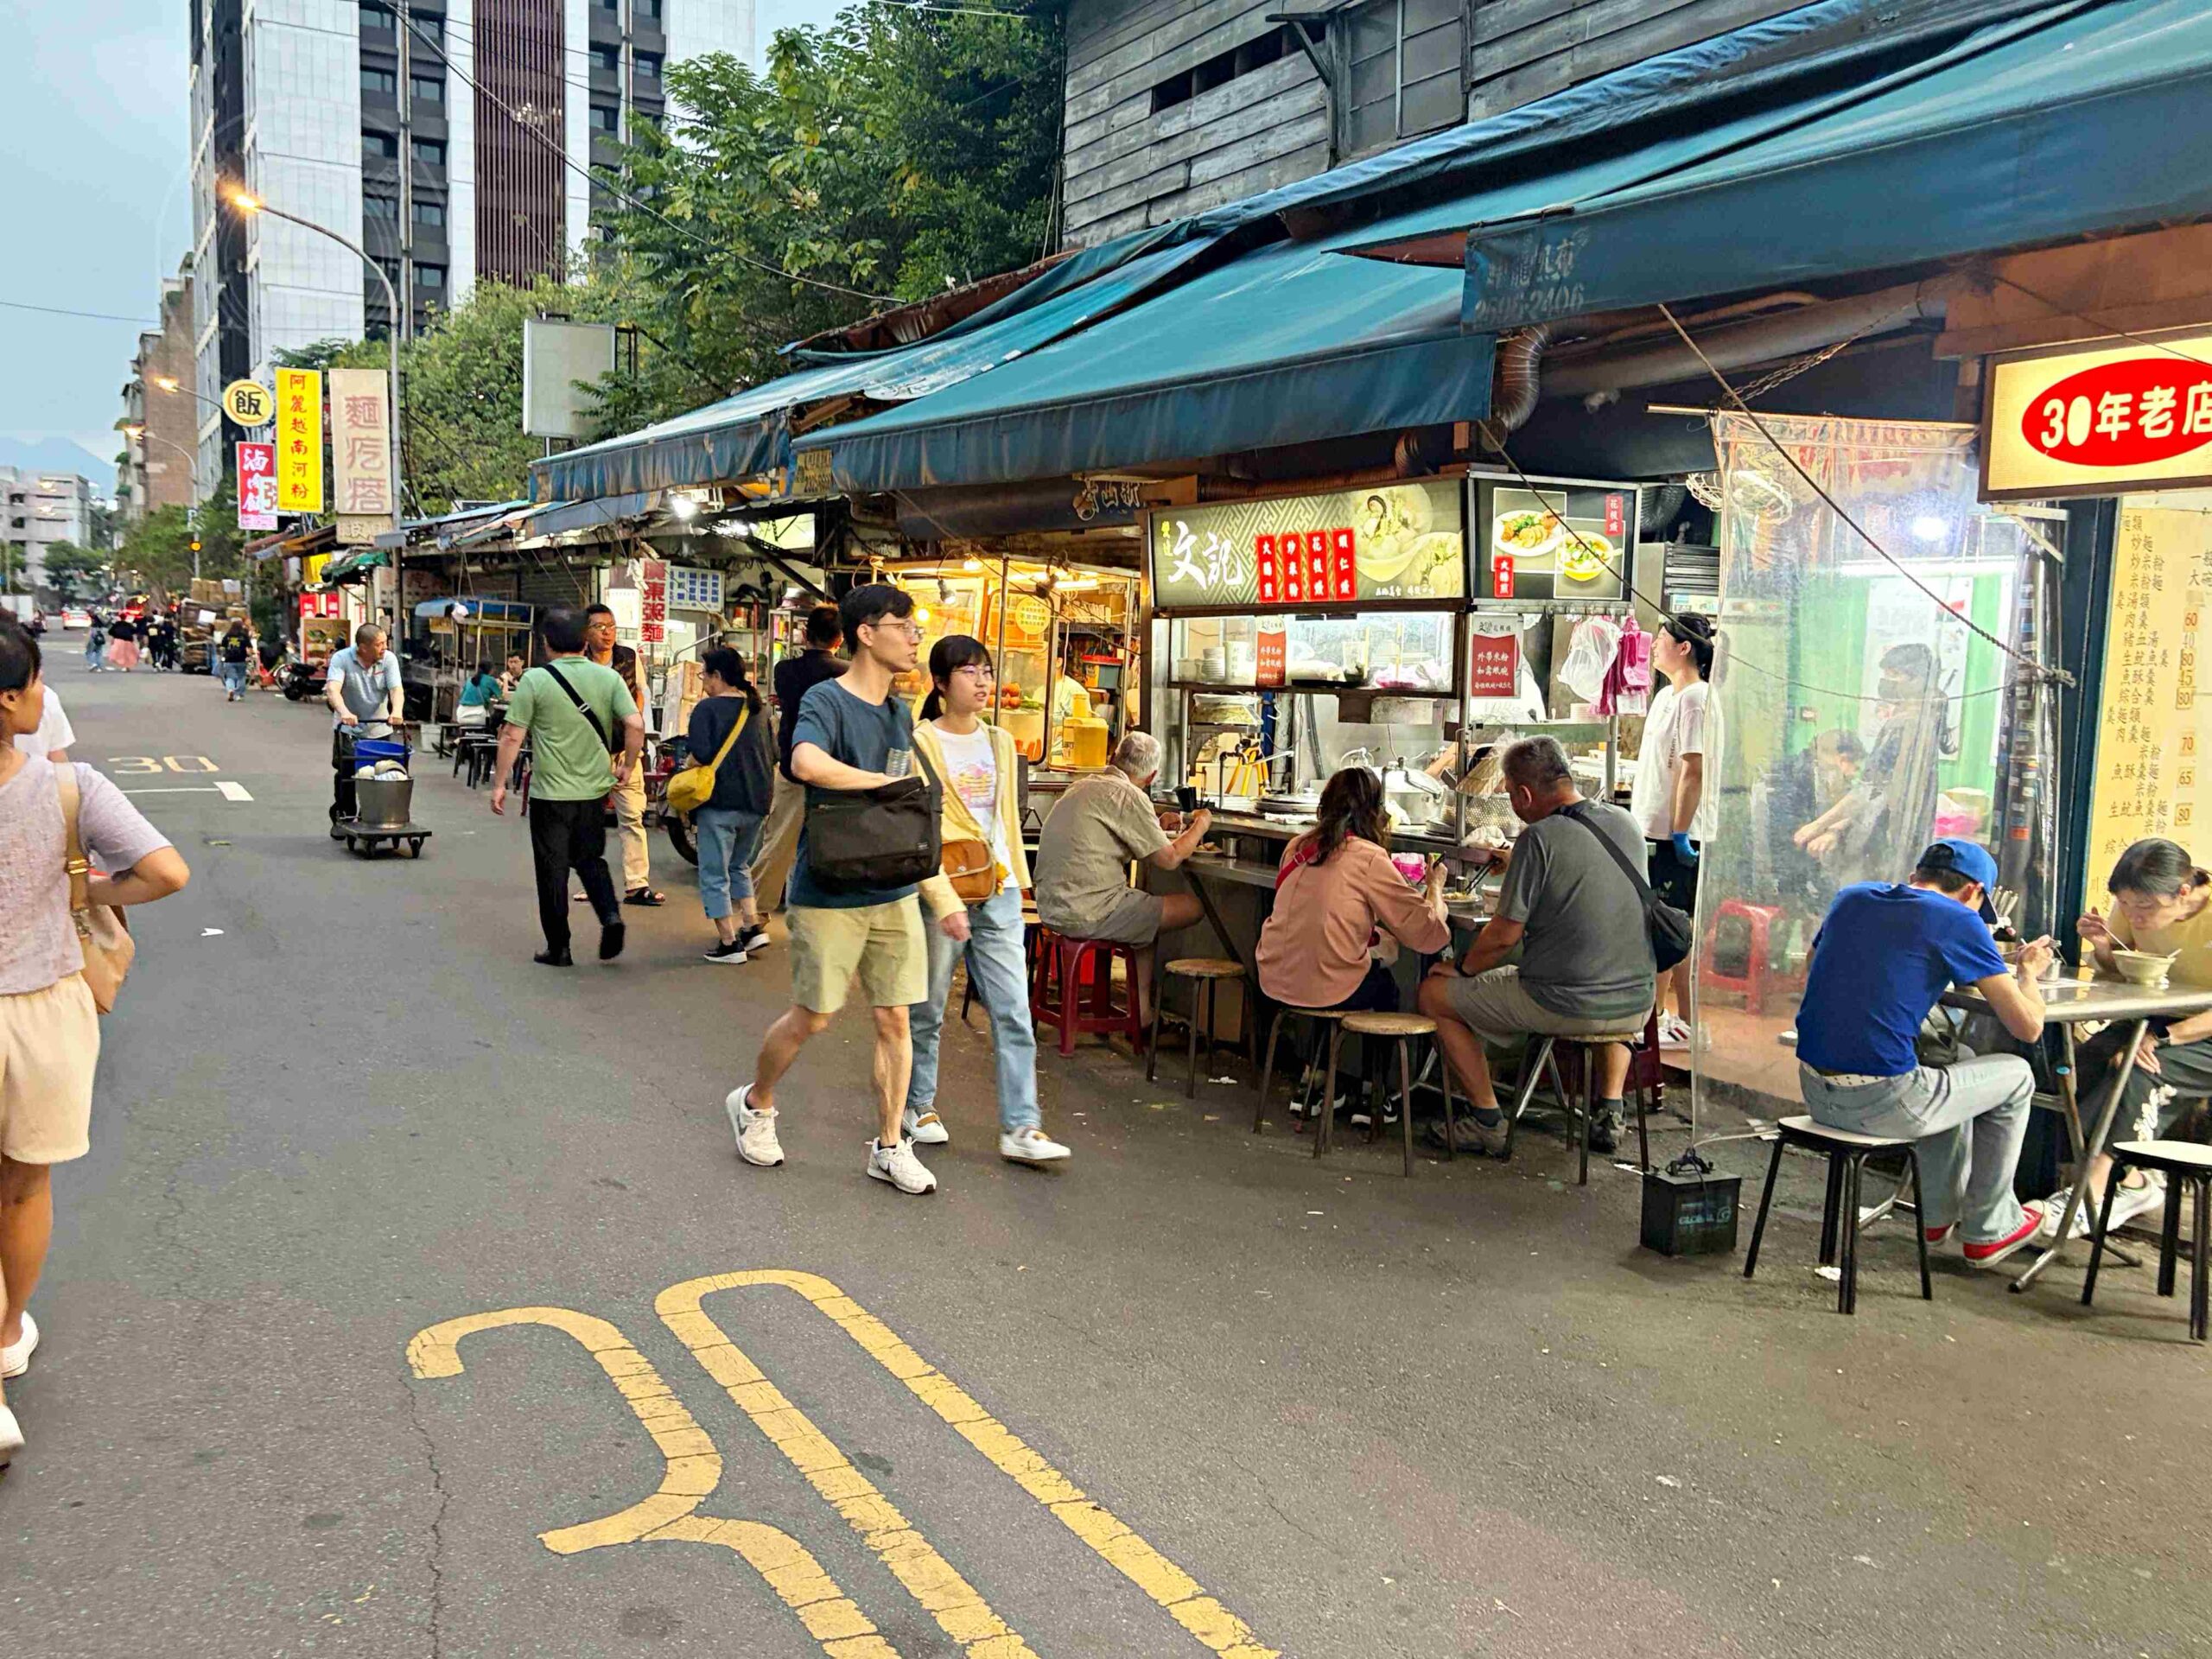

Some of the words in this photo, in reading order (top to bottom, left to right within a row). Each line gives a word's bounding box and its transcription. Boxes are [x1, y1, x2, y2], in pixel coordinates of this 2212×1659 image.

[235, 390, 262, 416] 飯
[289, 374, 309, 499] 阿麗越南河粉
[2041, 380, 2212, 449] 30年老店
[1168, 520, 1244, 591] 文記
[642, 562, 666, 643] 廣東粥麵
[107, 754, 220, 775] 30
[2181, 735, 2195, 752] 70
